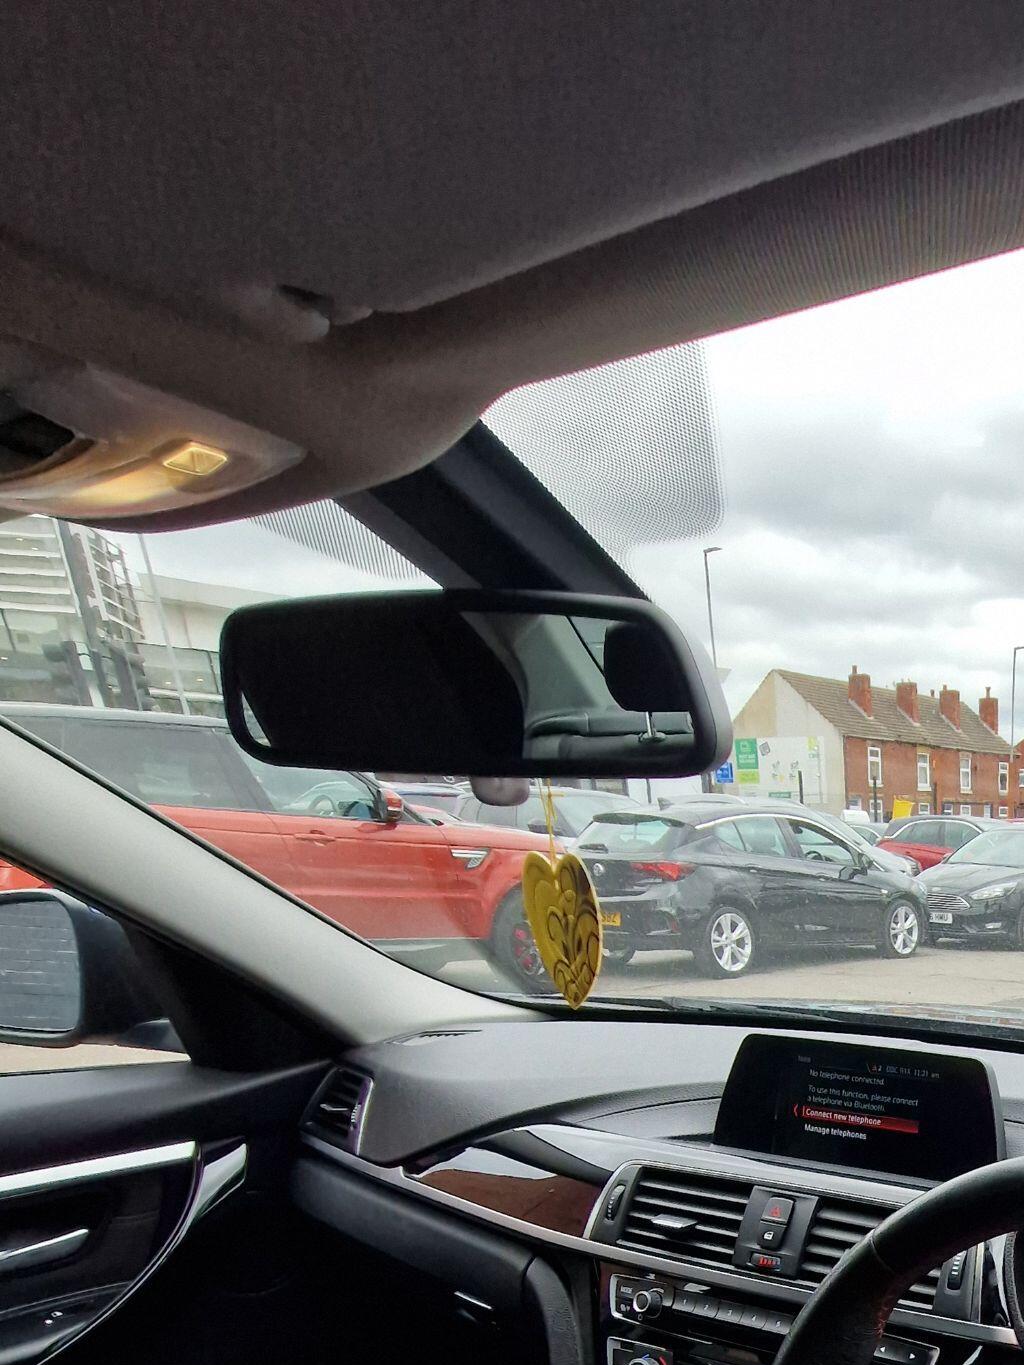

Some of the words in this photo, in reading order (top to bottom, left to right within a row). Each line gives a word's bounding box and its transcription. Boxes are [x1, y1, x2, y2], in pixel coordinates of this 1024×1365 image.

[810, 1069, 818, 1078] No
[820, 1070, 850, 1081] telephone
[812, 1096, 842, 1107] telephone
[871, 1094, 891, 1102] please
[892, 1096, 918, 1106] connect
[806, 1108, 832, 1120] Connect
[834, 1112, 847, 1121] new
[848, 1114, 882, 1126] telephone
[804, 1123, 830, 1135] Manage
[831, 1127, 867, 1140] telephones
